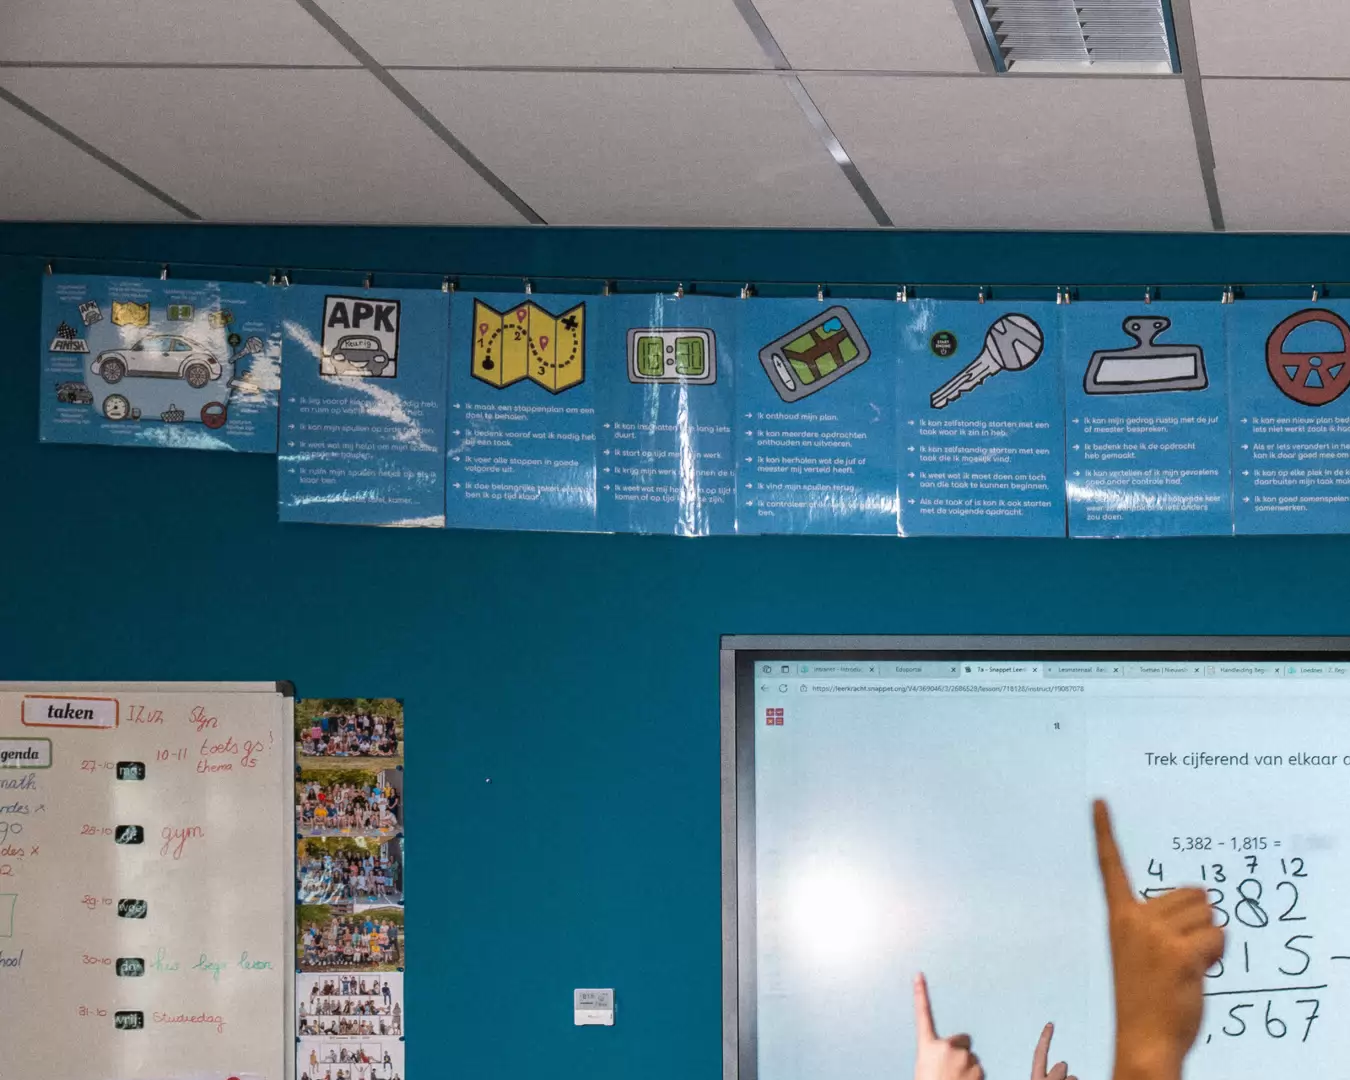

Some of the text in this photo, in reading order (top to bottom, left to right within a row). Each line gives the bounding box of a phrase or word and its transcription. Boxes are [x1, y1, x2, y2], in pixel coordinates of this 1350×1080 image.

[327, 302, 395, 333] APK
[514, 331, 521, 341] 2
[538, 366, 545, 375] 3
[944, 420, 986, 428] zelfstandig
[1108, 417, 1124, 425] mijn
[1126, 417, 1153, 425] gedrag
[1156, 416, 1178, 425] rustig
[1208, 416, 1218, 424] juf
[48, 703, 94, 720] taken
[1145, 752, 1177, 766] Trek
[1183, 752, 1249, 769] cijferend
[1254, 755, 1283, 766] van
[1288, 752, 1338, 766] elkaar
[161, 825, 205, 860] gym
[1172, 836, 1212, 853] 5,382
[1231, 836, 1268, 853] 1,815
[1147, 855, 1308, 883] 4 13 7 12
